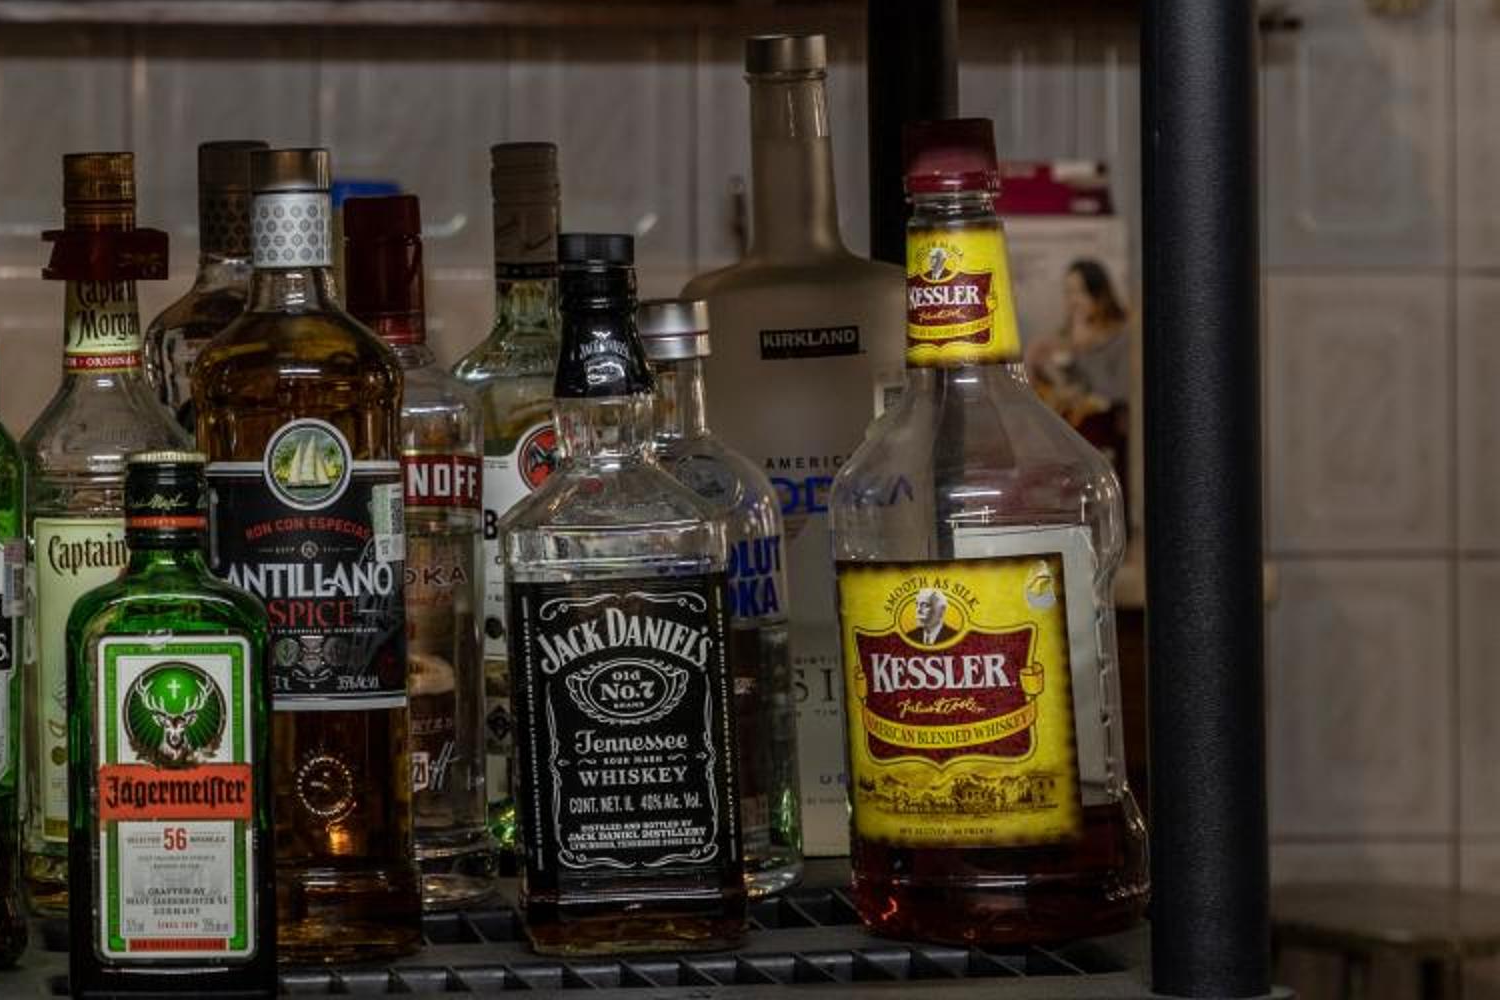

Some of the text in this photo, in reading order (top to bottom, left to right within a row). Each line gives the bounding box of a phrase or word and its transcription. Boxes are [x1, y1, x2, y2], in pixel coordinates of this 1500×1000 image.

[76, 309, 138, 347] Morga
[763, 329, 856, 347] KIRKLAND
[765, 456, 844, 469] AMERIC
[406, 465, 478, 497] NOFF
[48, 531, 130, 576] Captain
[227, 560, 394, 598] ANTILLANO
[933, 578, 949, 590] AS
[537, 608, 713, 675] JACK DANIEL'S
[612, 669, 641, 682] Old
[870, 654, 1012, 693] KESSLER
[600, 681, 655, 701] No.7
[575, 729, 689, 755] Tennessee
[916, 727, 972, 745] BLENDED
[579, 766, 689, 787] WHISKEY
[163, 828, 188, 850] 56
